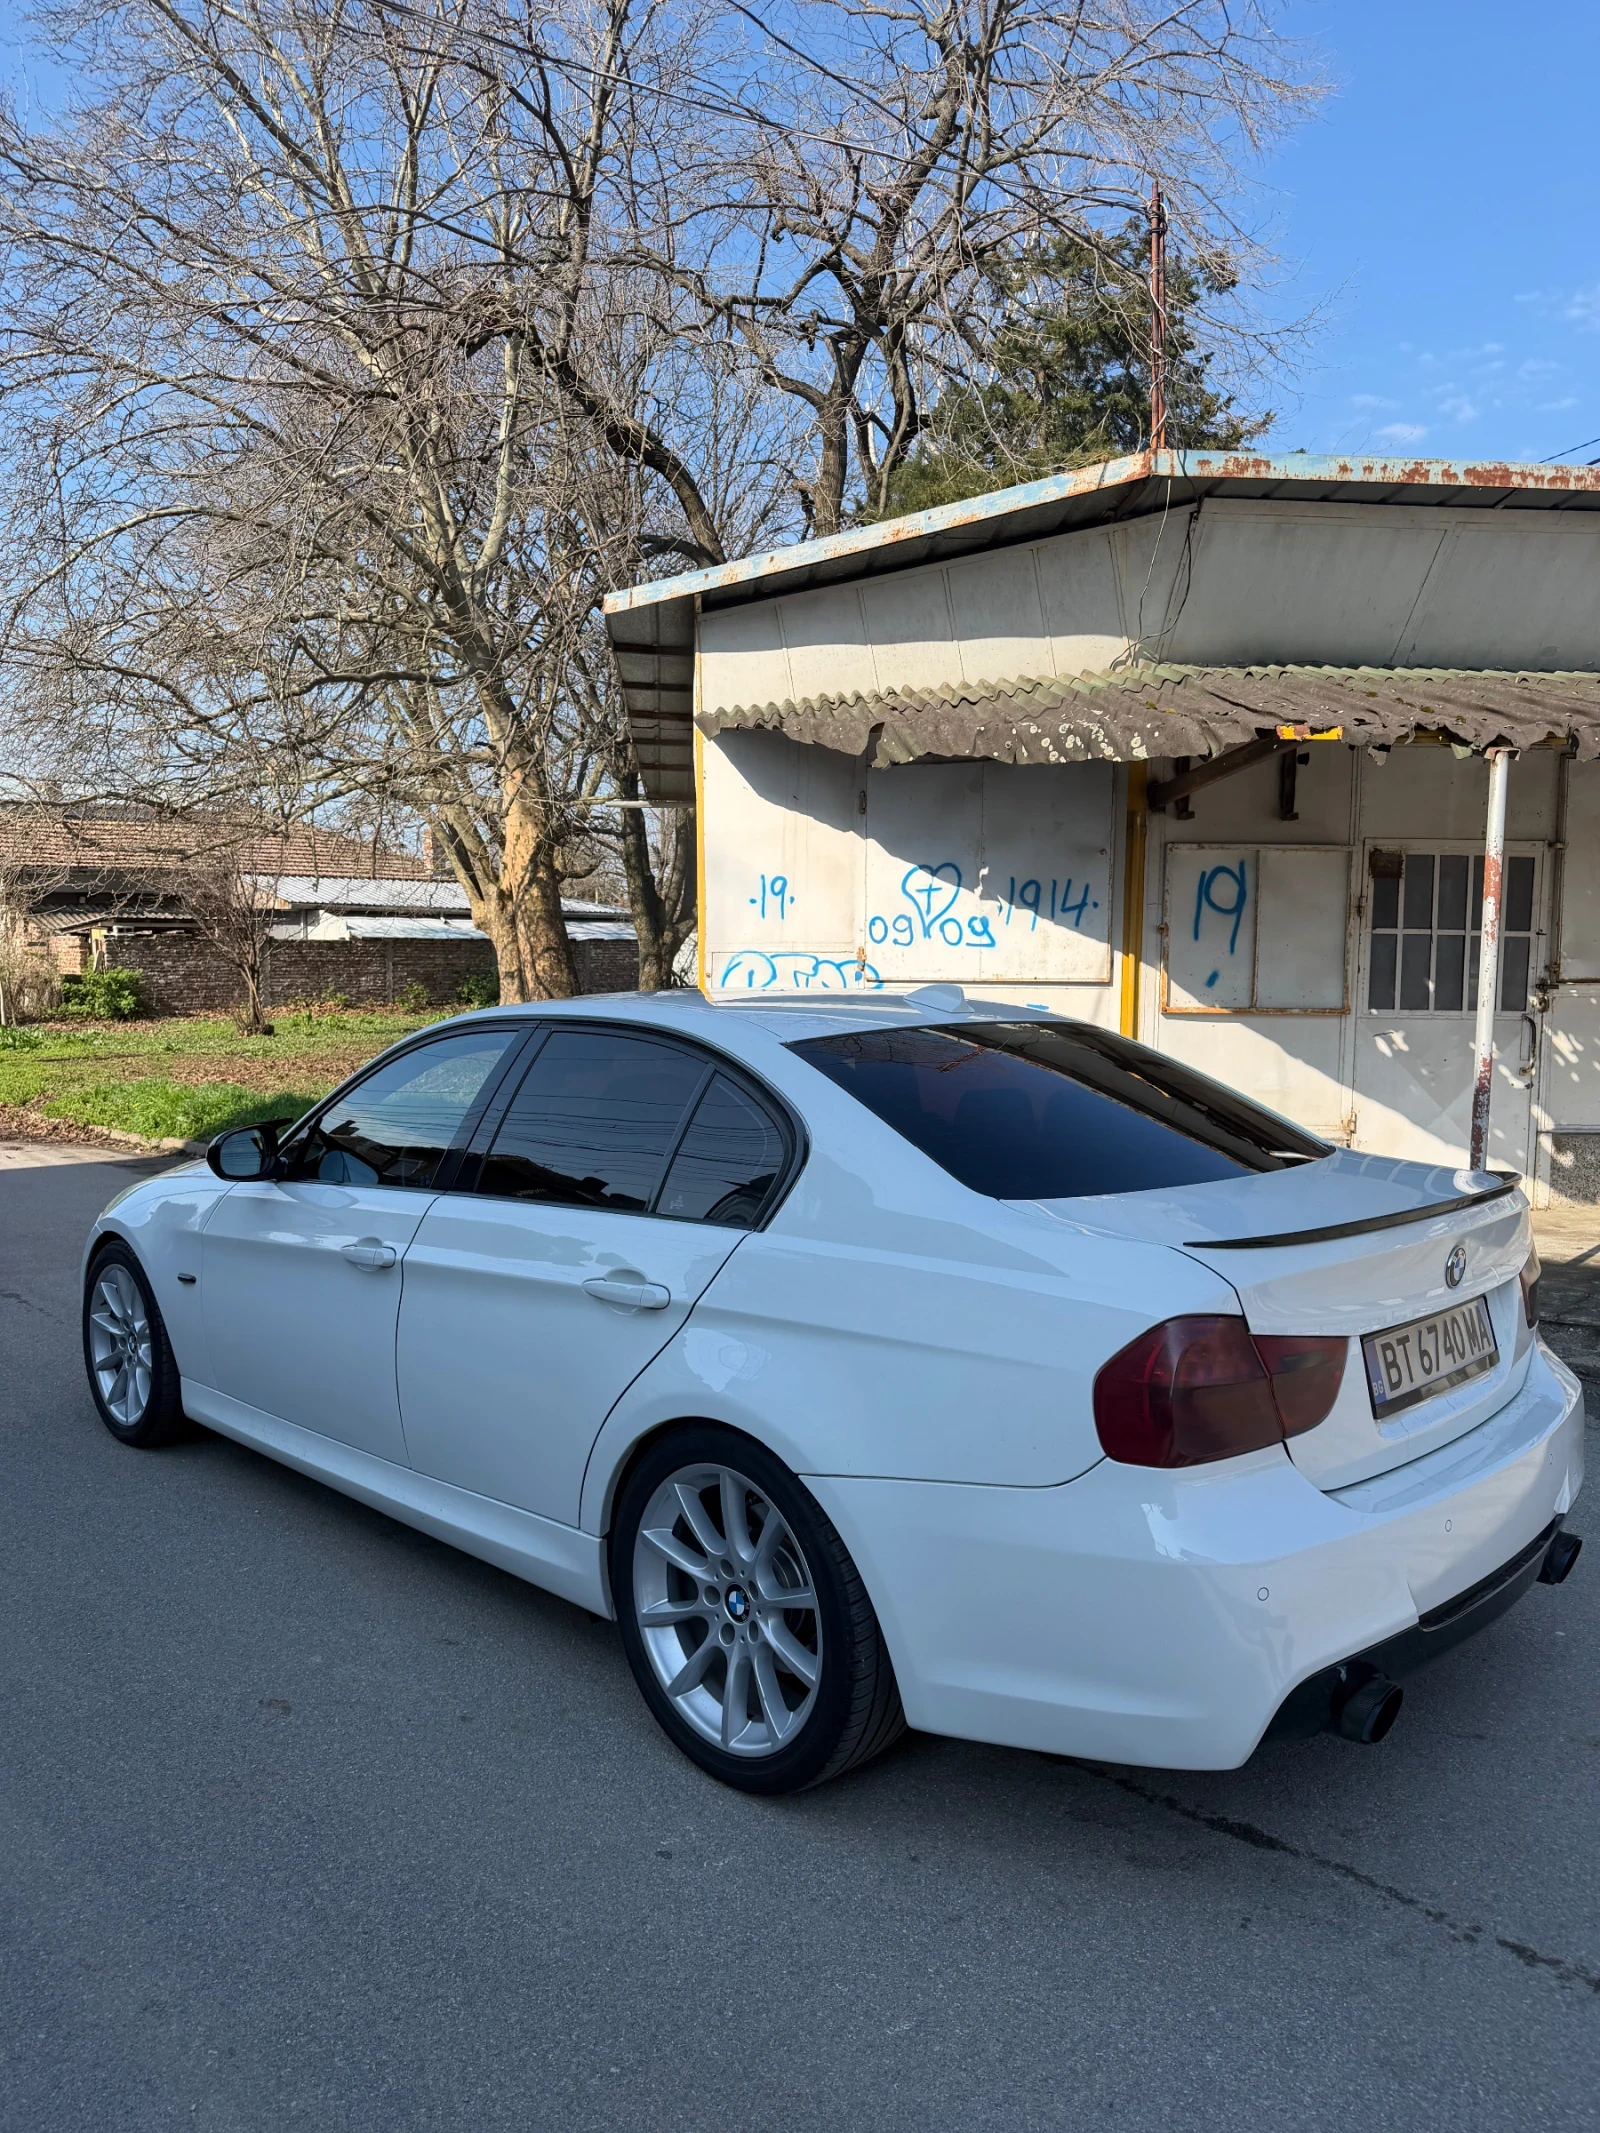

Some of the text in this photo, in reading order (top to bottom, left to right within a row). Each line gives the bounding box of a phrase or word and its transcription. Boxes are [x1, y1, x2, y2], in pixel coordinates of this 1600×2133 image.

[1380, 1305, 1492, 1392] BT 6740 MA
[1373, 1380, 1384, 1396] BG
